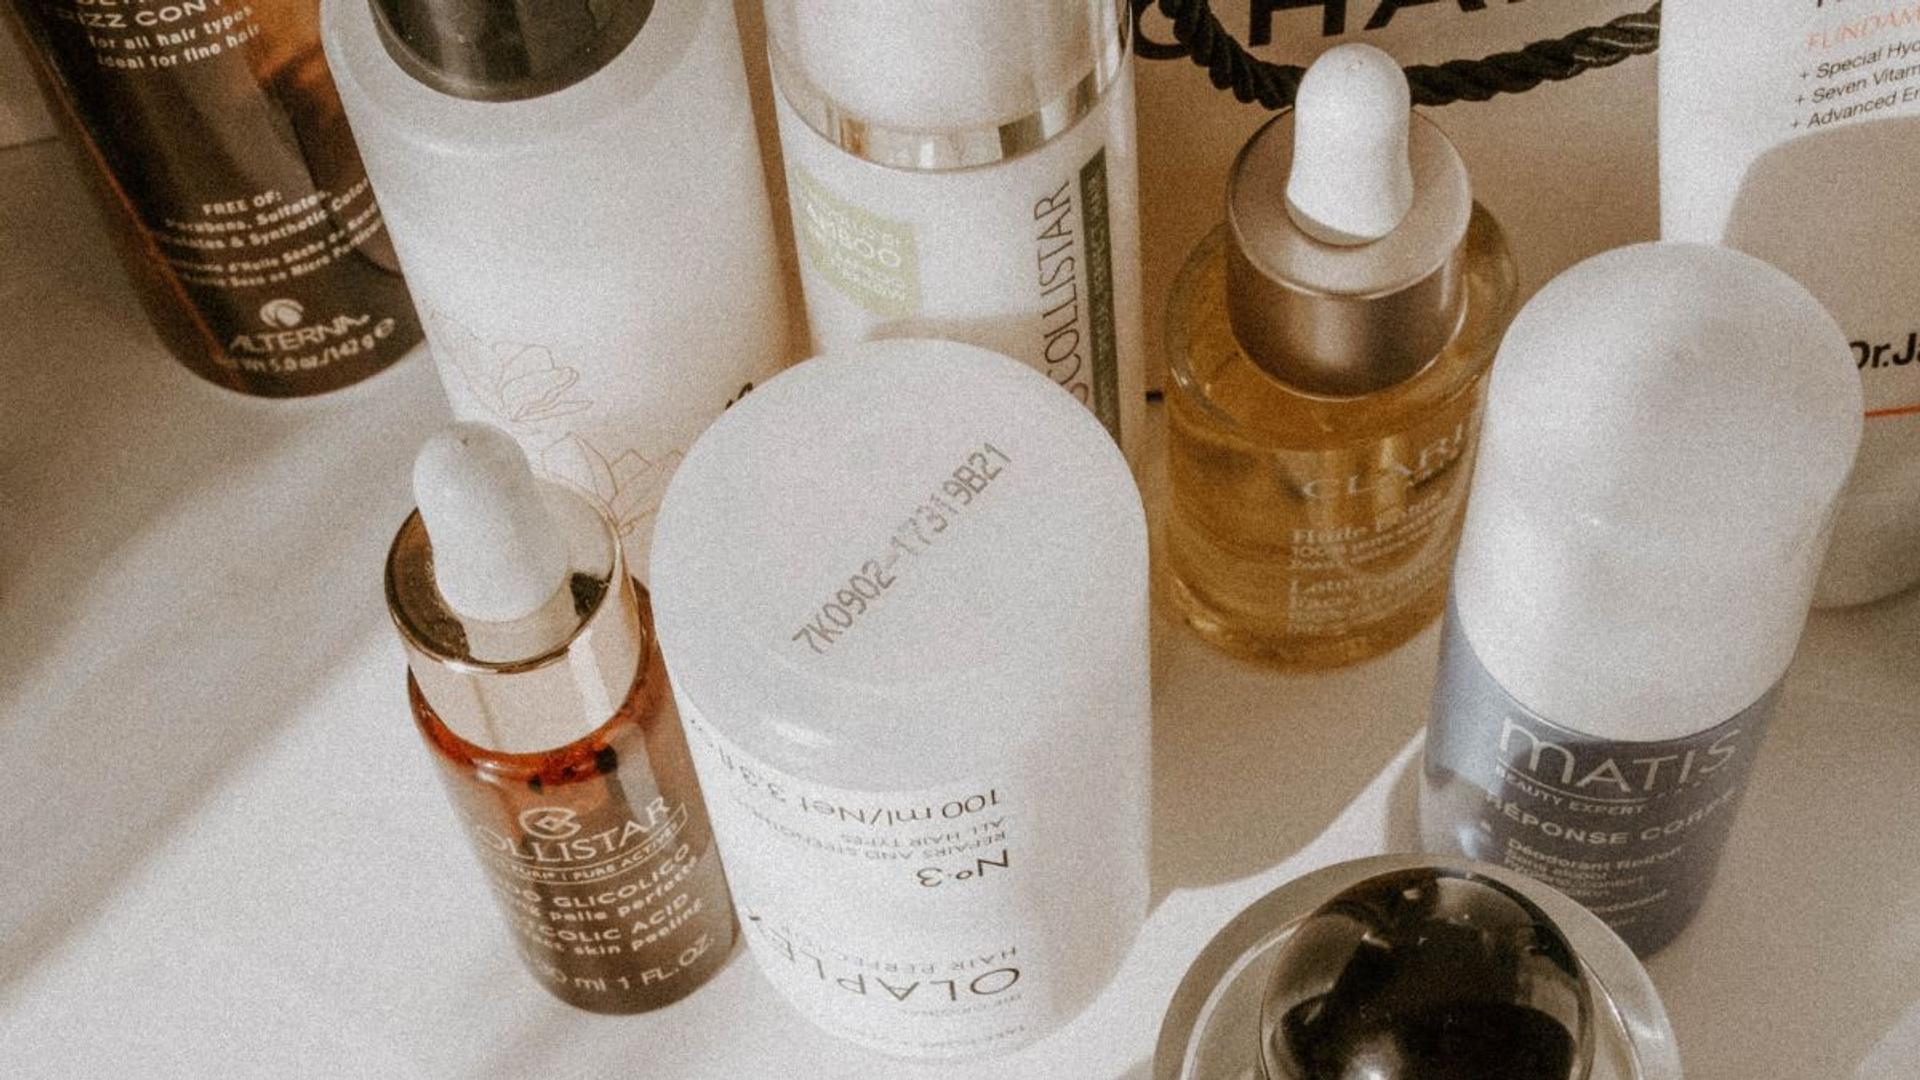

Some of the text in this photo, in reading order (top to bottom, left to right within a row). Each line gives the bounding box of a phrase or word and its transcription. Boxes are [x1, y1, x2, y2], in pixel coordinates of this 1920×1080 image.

[124, 36, 151, 49] all
[156, 27, 197, 46] hair
[203, 6, 253, 35] types
[150, 55, 177, 68] for
[184, 43, 221, 62] fine
[226, 24, 260, 48] hair
[1816, 46, 1883, 79] Special
[1811, 78, 1867, 104] Seven
[1807, 91, 1897, 128] Advanced
[203, 200, 248, 216] FREE
[250, 211, 327, 245] Synthetic
[230, 313, 370, 353] ALTERNA
[1849, 332, 1920, 369] Dr.J
[1501, 716, 1741, 794] MATIS
[941, 789, 1001, 819] 100
[1568, 799, 1646, 816] EXPERT
[475, 796, 671, 862] OLLISTAR
[909, 832, 960, 846] HAIR
[973, 816, 1006, 836] ALL
[865, 846, 913, 861] AND
[922, 832, 1006, 857] REPAIRS
[553, 843, 689, 908] GLICOLICO
[573, 944, 621, 956] skin
[631, 897, 702, 952] peeling
[632, 892, 688, 934] ACID
[952, 945, 1017, 972] HAIR
